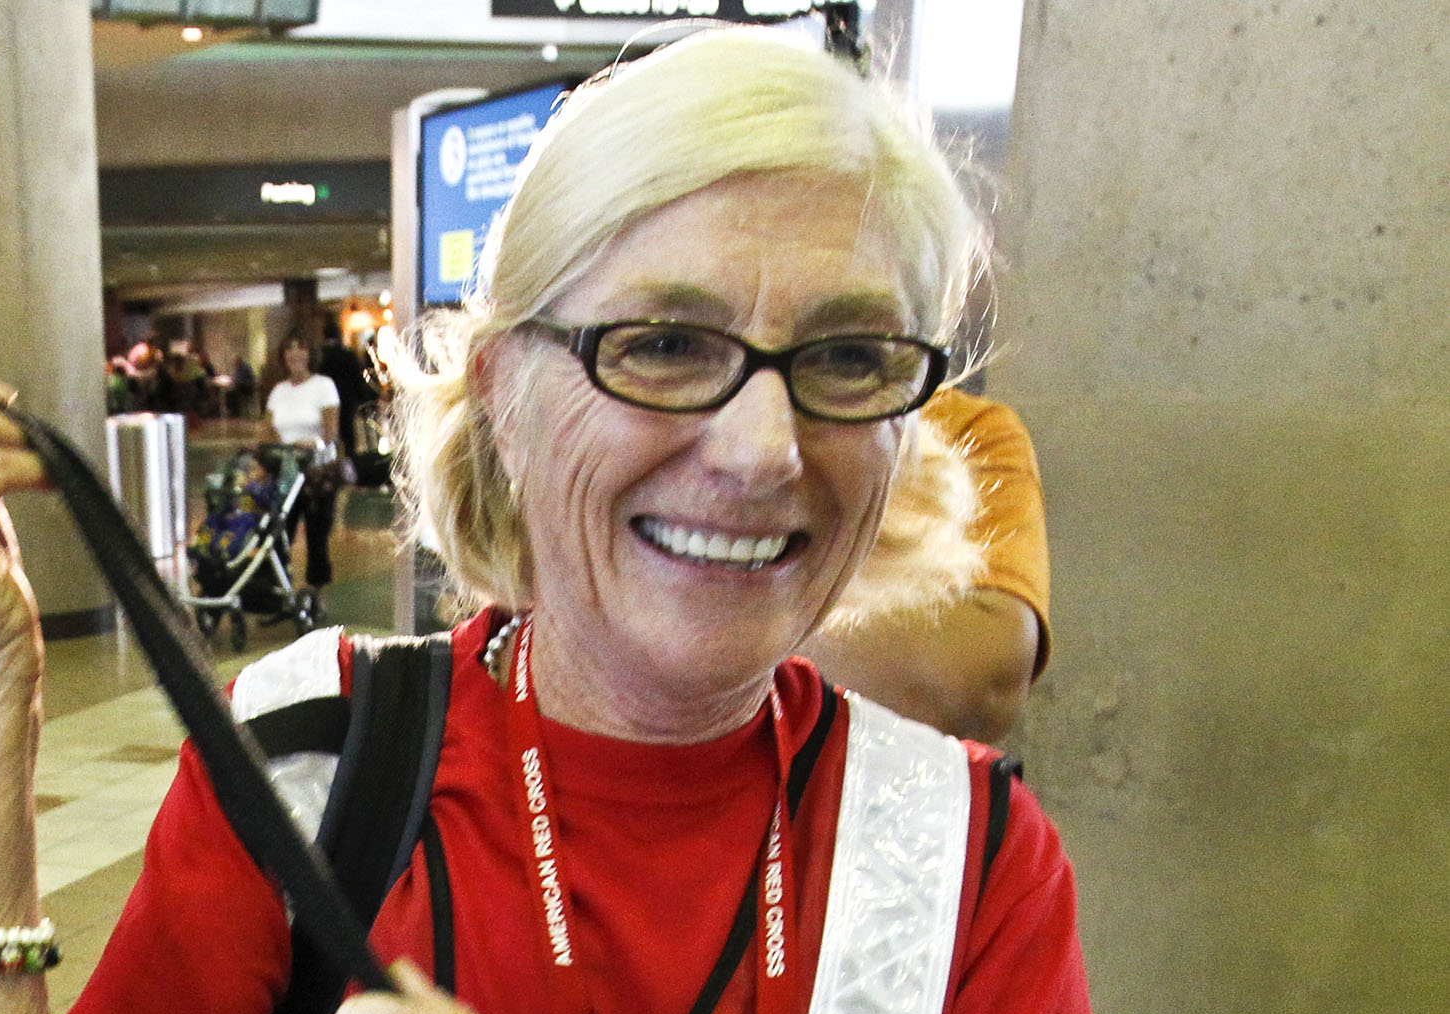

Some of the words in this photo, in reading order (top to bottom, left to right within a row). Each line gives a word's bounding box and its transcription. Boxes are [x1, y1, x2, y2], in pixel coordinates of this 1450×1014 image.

[521, 746, 547, 815] CROSS
[531, 814, 554, 858] RED
[537, 858, 574, 967] AMERICAN
[765, 860, 784, 905] RED
[765, 905, 786, 979] CROSS
